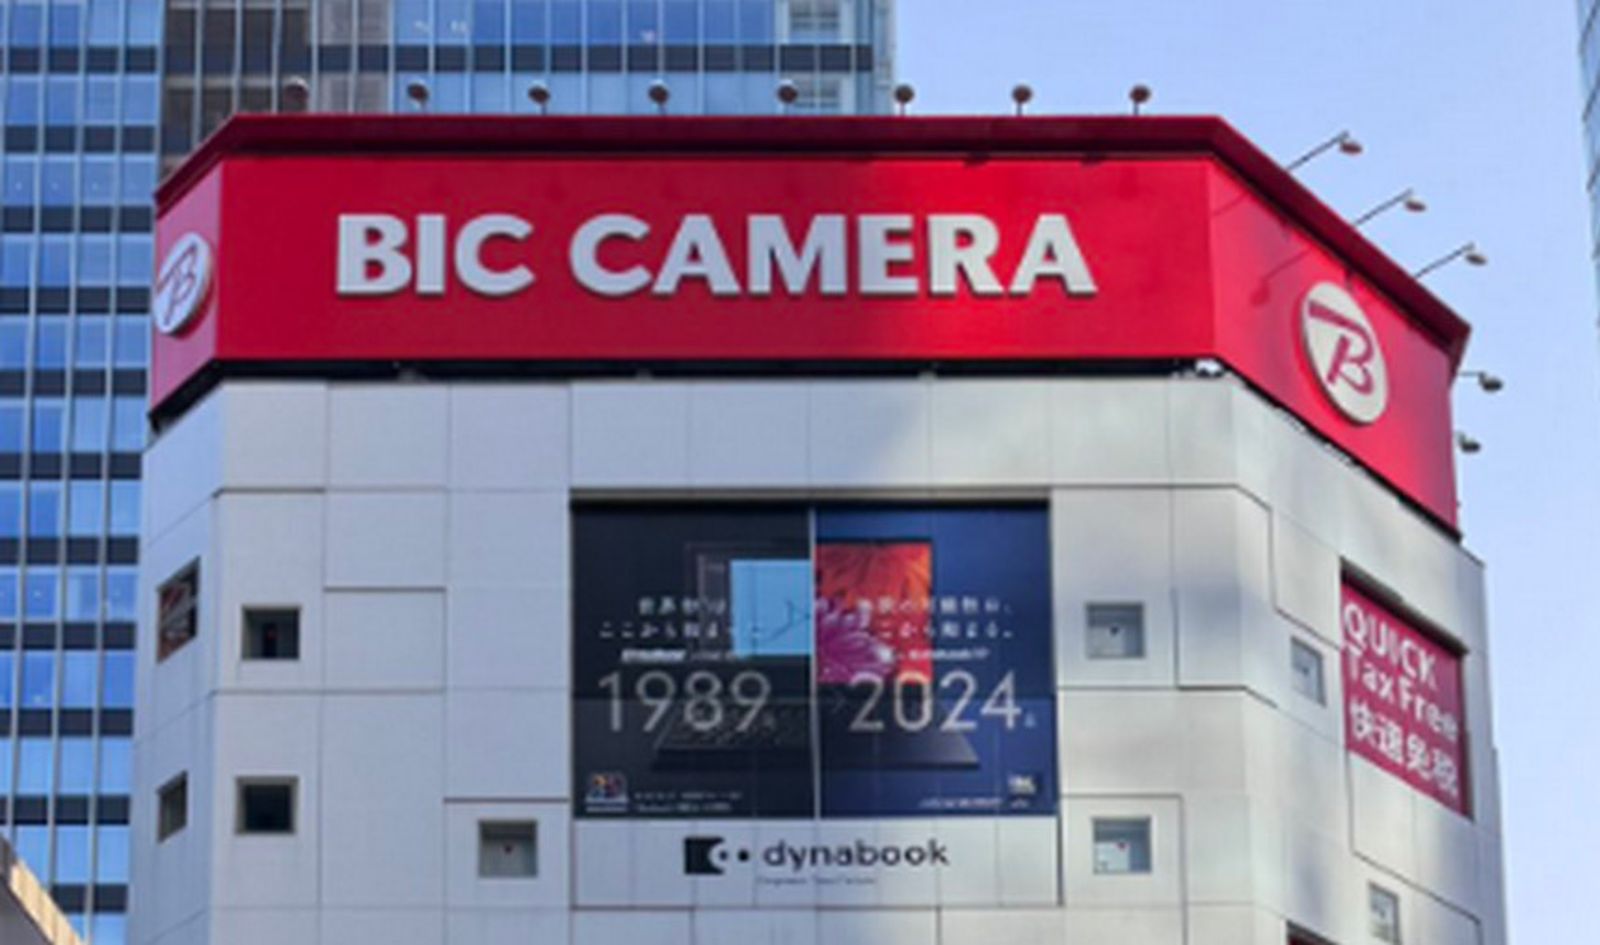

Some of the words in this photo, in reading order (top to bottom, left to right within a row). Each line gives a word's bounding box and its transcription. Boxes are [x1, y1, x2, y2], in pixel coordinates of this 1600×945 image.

[337, 213, 534, 295] BIC
[569, 213, 1096, 295] CAMERA
[1344, 602, 1437, 692] QUICK
[598, 669, 772, 733] 1989
[849, 668, 1022, 732] 2024
[1342, 641, 1394, 704] Tax
[1398, 675, 1458, 742] Free
[763, 838, 949, 871] dynabook
